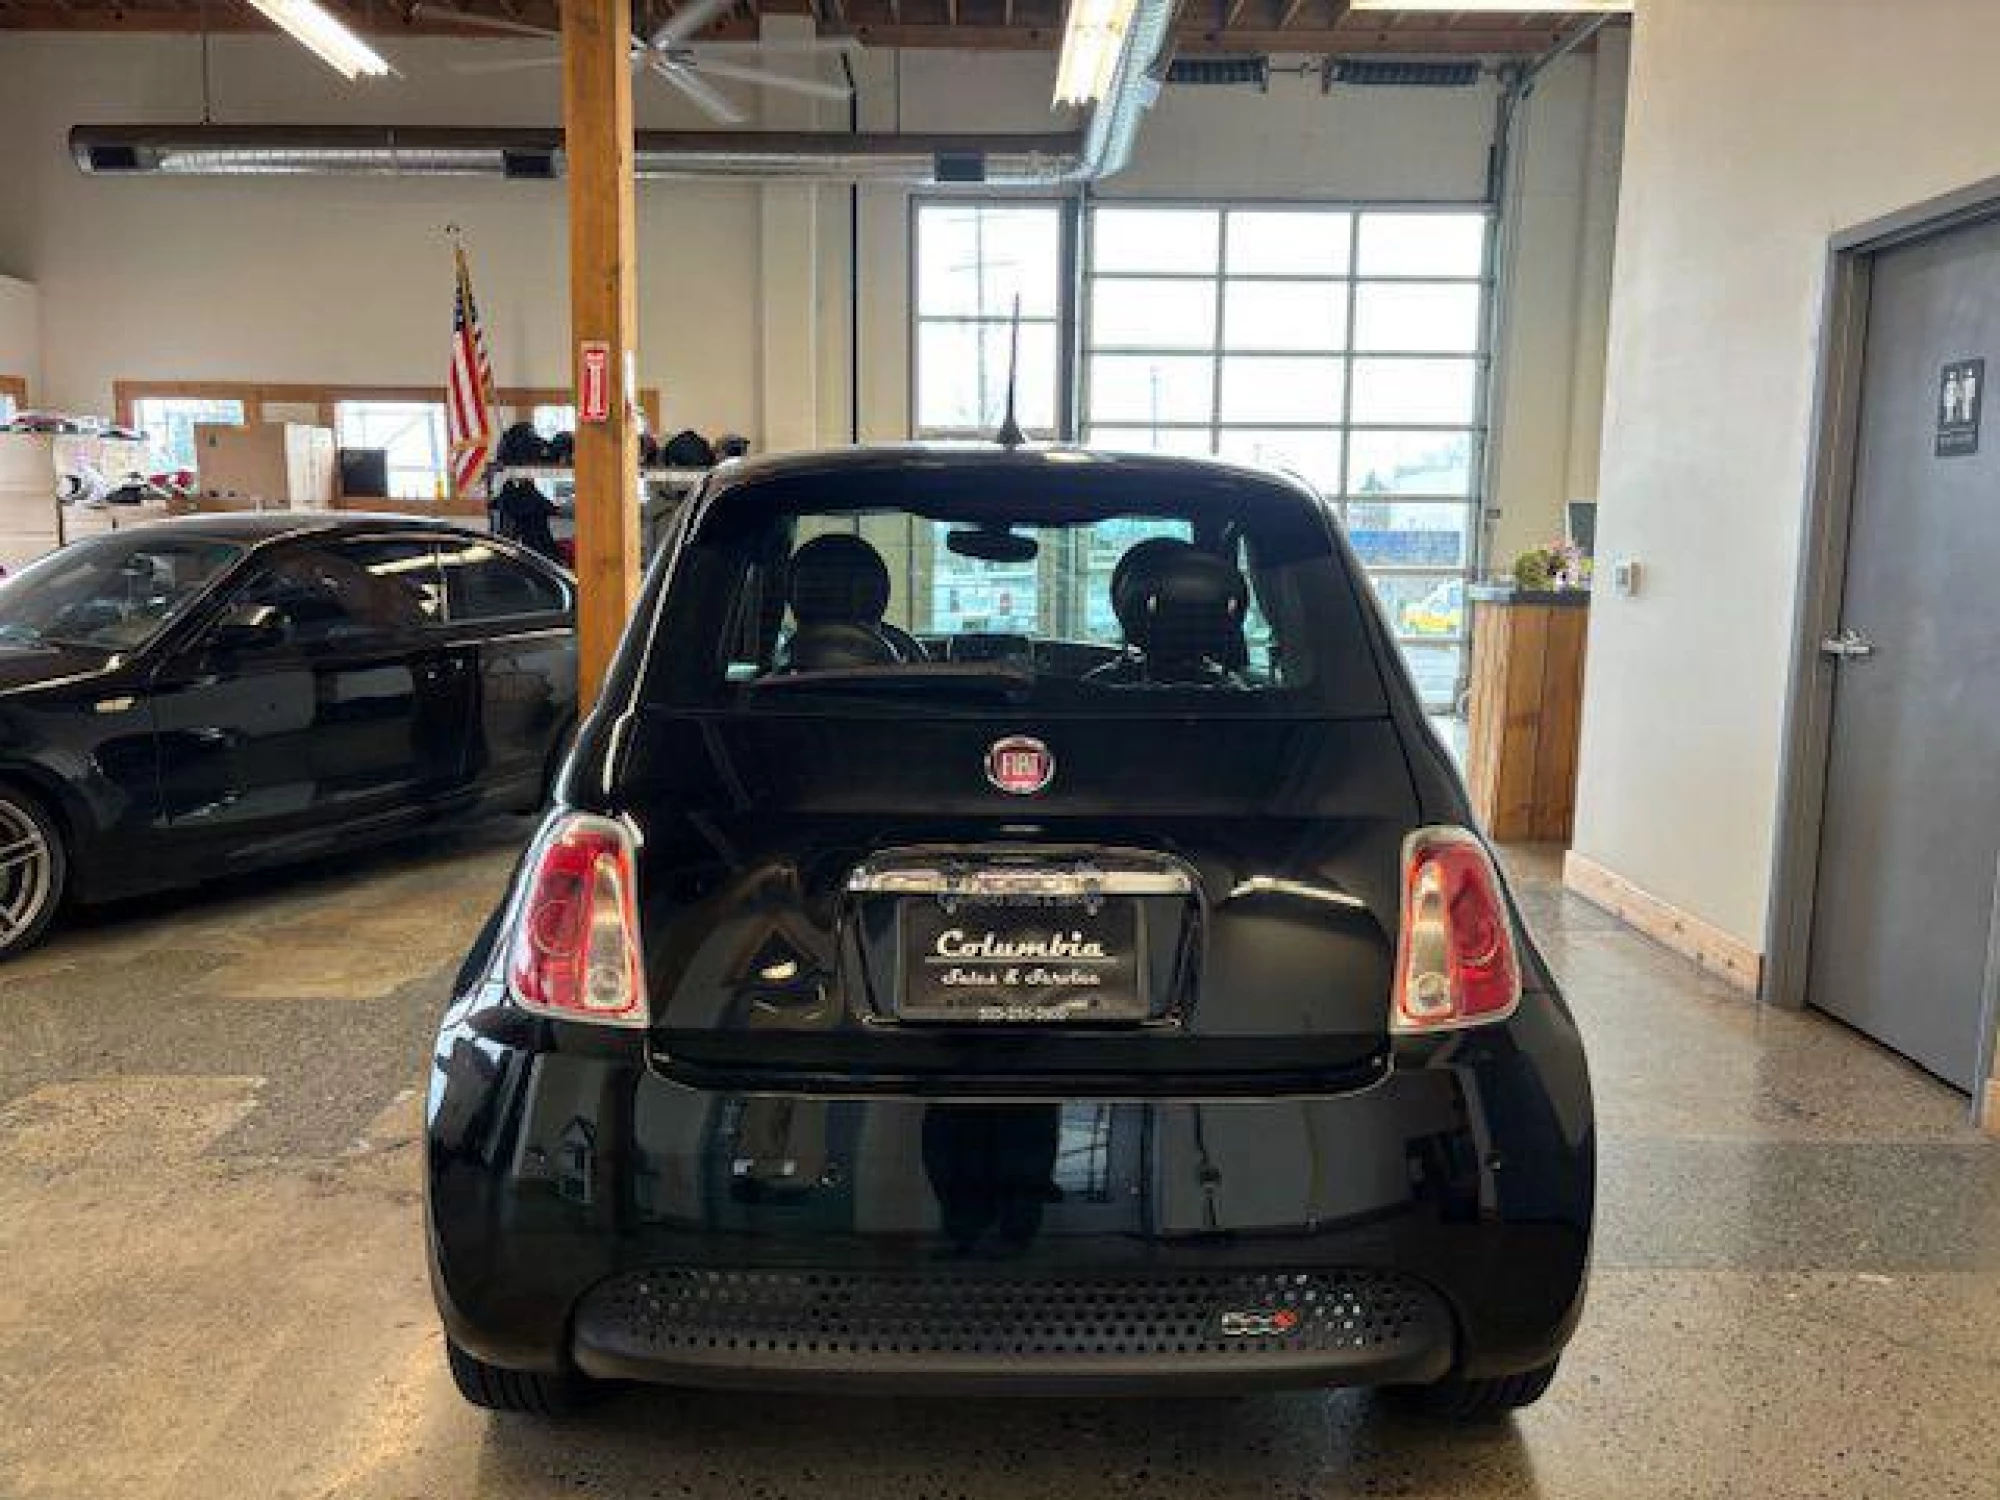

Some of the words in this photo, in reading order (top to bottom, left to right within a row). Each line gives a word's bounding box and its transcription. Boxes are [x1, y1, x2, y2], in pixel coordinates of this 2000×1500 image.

[1002, 752, 1039, 776] FIAT
[936, 929, 1104, 957] Columbia
[941, 968, 998, 986] Sales
[1002, 968, 1020, 986] &
[1024, 968, 1101, 986] Service
